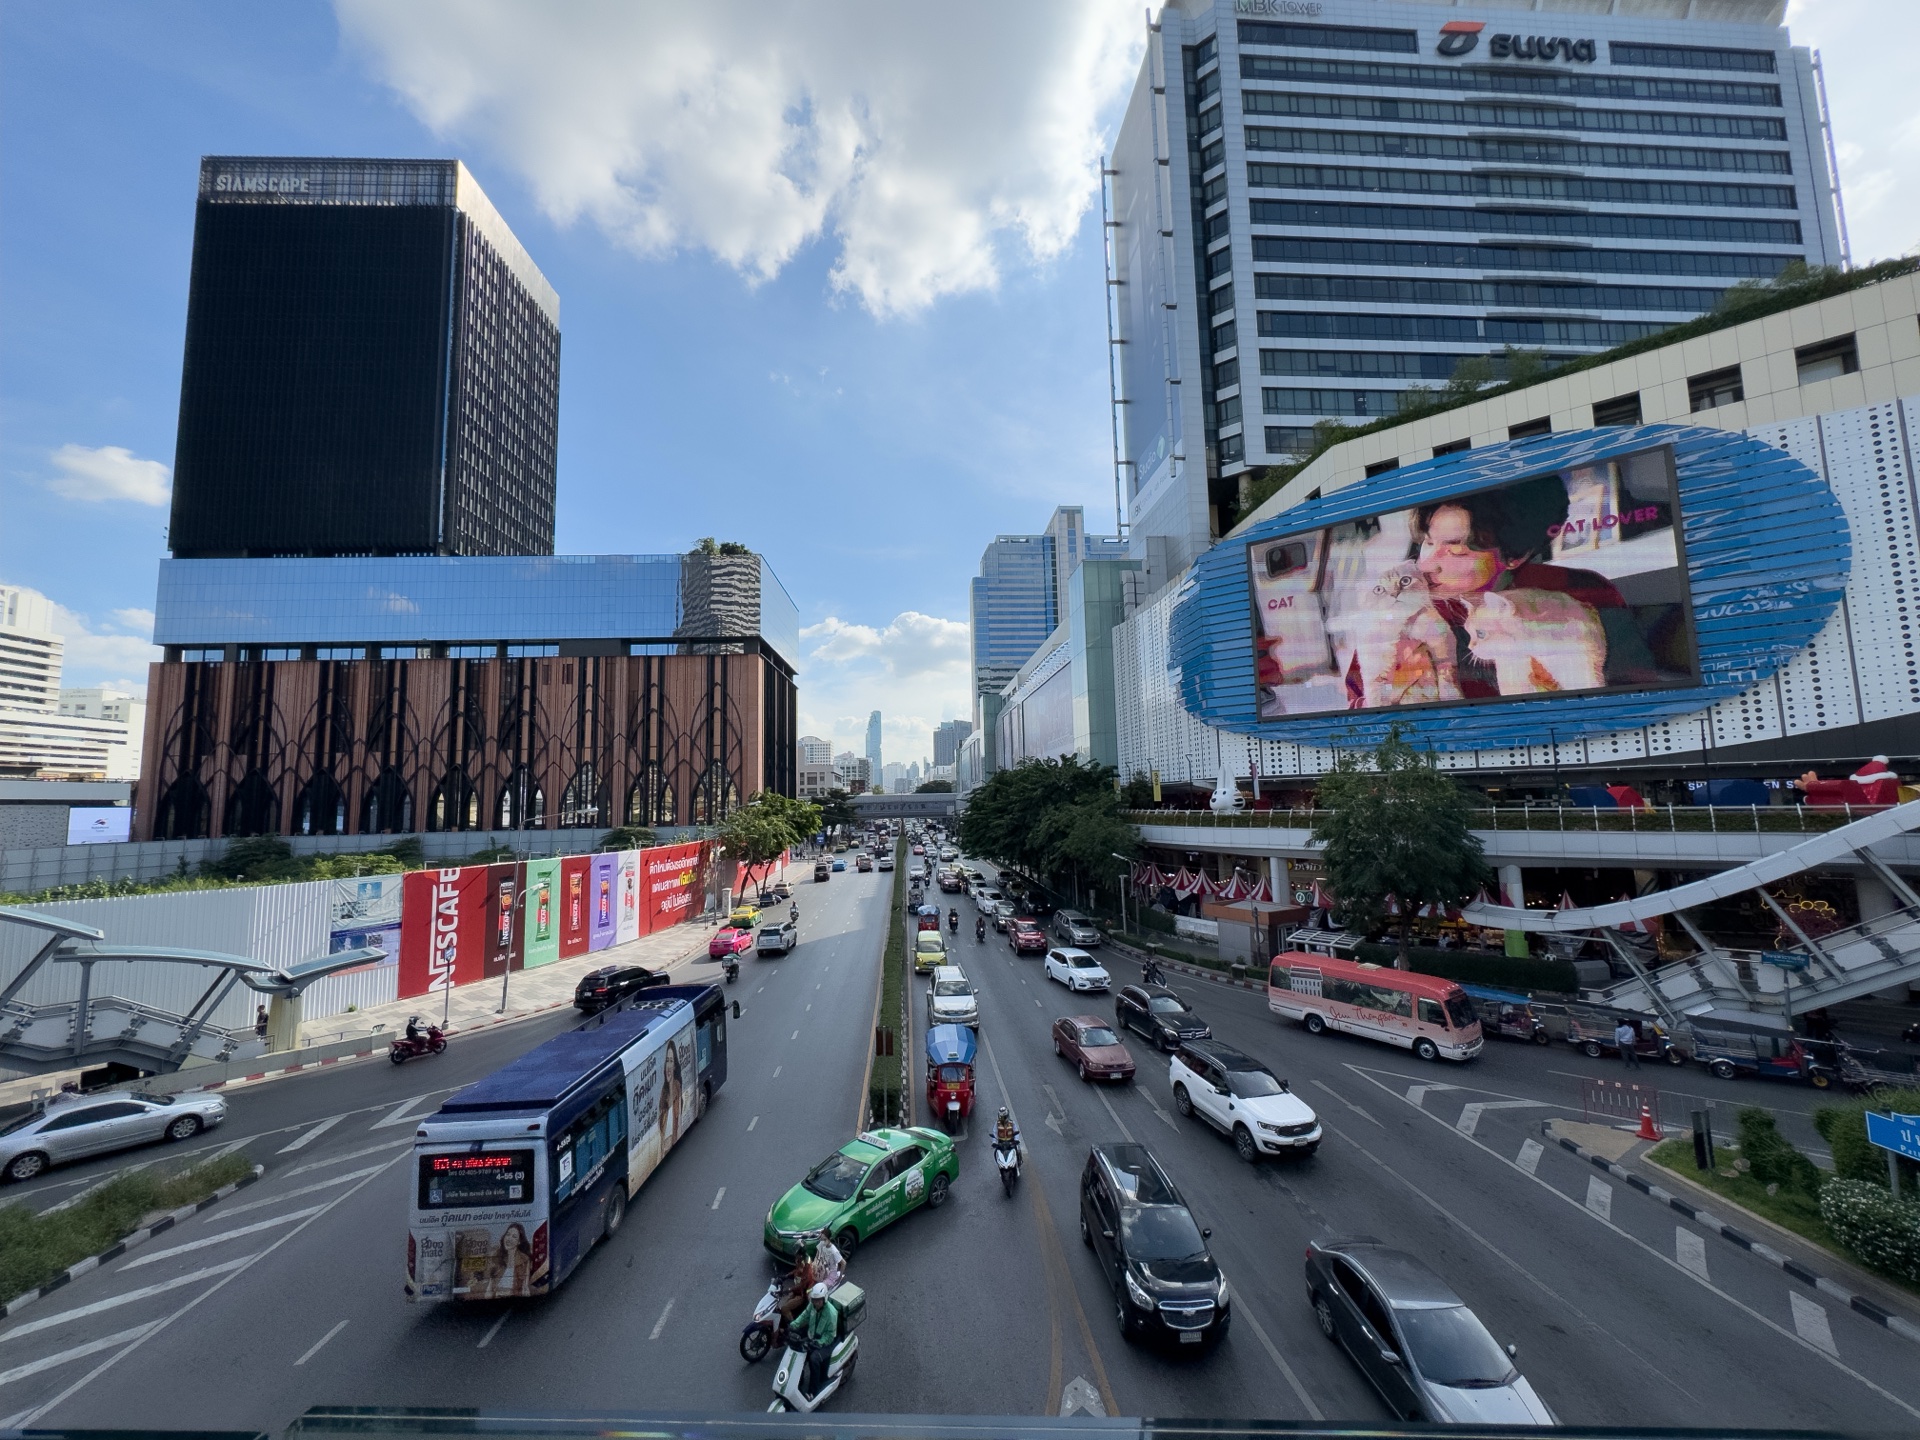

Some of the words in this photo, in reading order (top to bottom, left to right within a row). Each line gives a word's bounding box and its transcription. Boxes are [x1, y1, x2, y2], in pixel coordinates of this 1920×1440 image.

[1280, 1, 1323, 15] TOWER
[1490, 33, 1597, 62] ธนชาต
[216, 174, 310, 193] SIAMSCAPE
[1547, 518, 1586, 539] CAT
[1592, 505, 1659, 530] LOVER
[1267, 594, 1294, 611] CAT
[1353, 1007, 1403, 1027] Thompson
[514, 1172, 525, 1181] (3)
[473, 1212, 493, 1221] อร่อย
